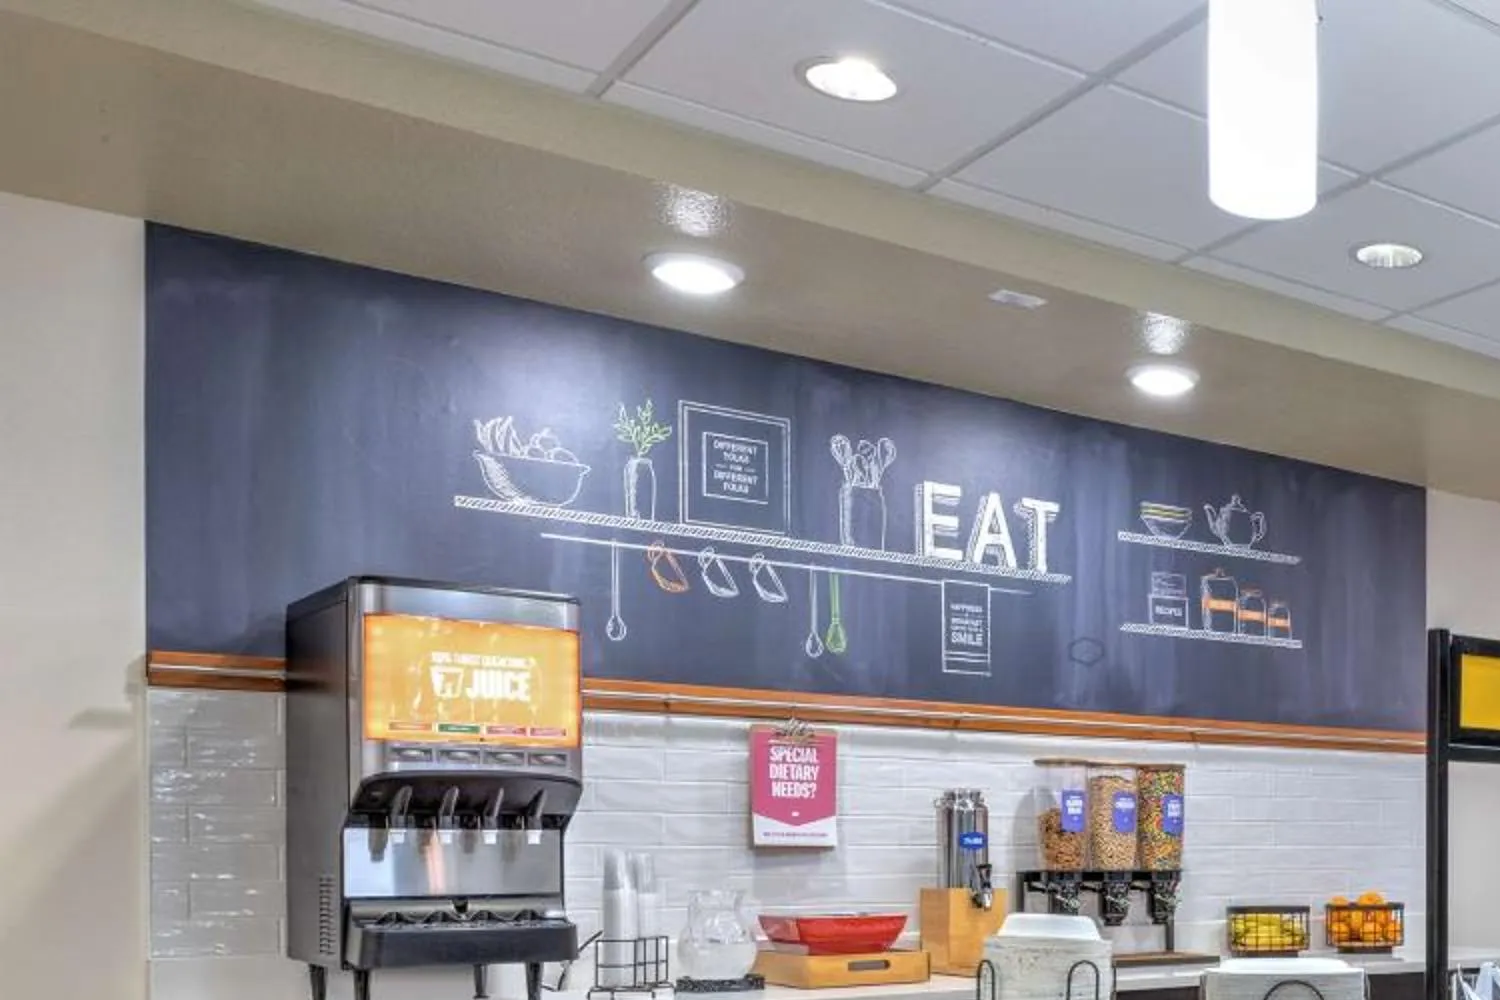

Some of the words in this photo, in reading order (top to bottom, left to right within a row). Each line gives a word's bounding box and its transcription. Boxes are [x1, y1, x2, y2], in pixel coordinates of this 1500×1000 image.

[914, 480, 1060, 575] EAT
[951, 631, 983, 647] SMILE
[465, 669, 531, 702] JUICE
[769, 747, 820, 763] SPECIAL
[769, 764, 820, 780] DIETARY
[771, 782, 817, 799] NEEDS?
